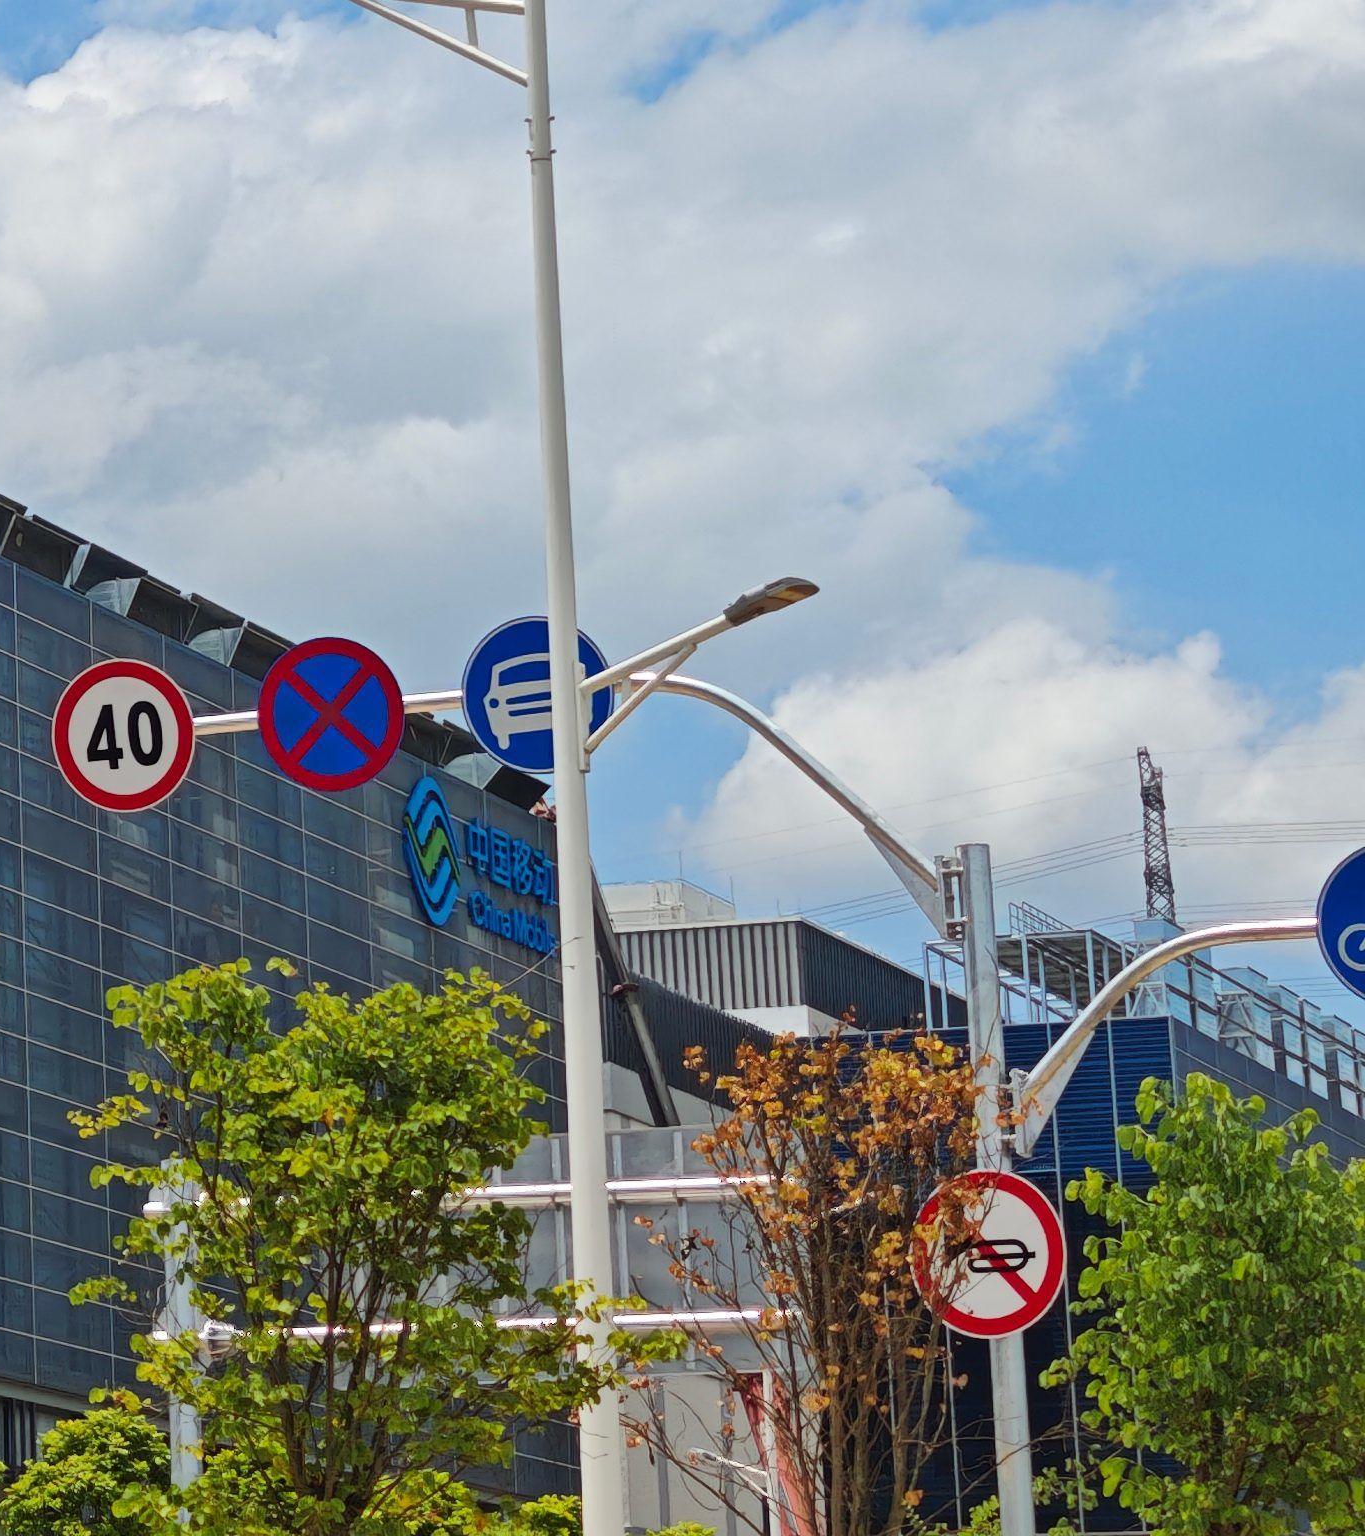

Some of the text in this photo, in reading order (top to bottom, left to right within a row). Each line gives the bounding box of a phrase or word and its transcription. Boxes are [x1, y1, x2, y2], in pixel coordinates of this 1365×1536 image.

[87, 700, 164, 770] 40
[465, 818, 556, 906] 中国移动
[468, 890, 556, 955] China Mobile
